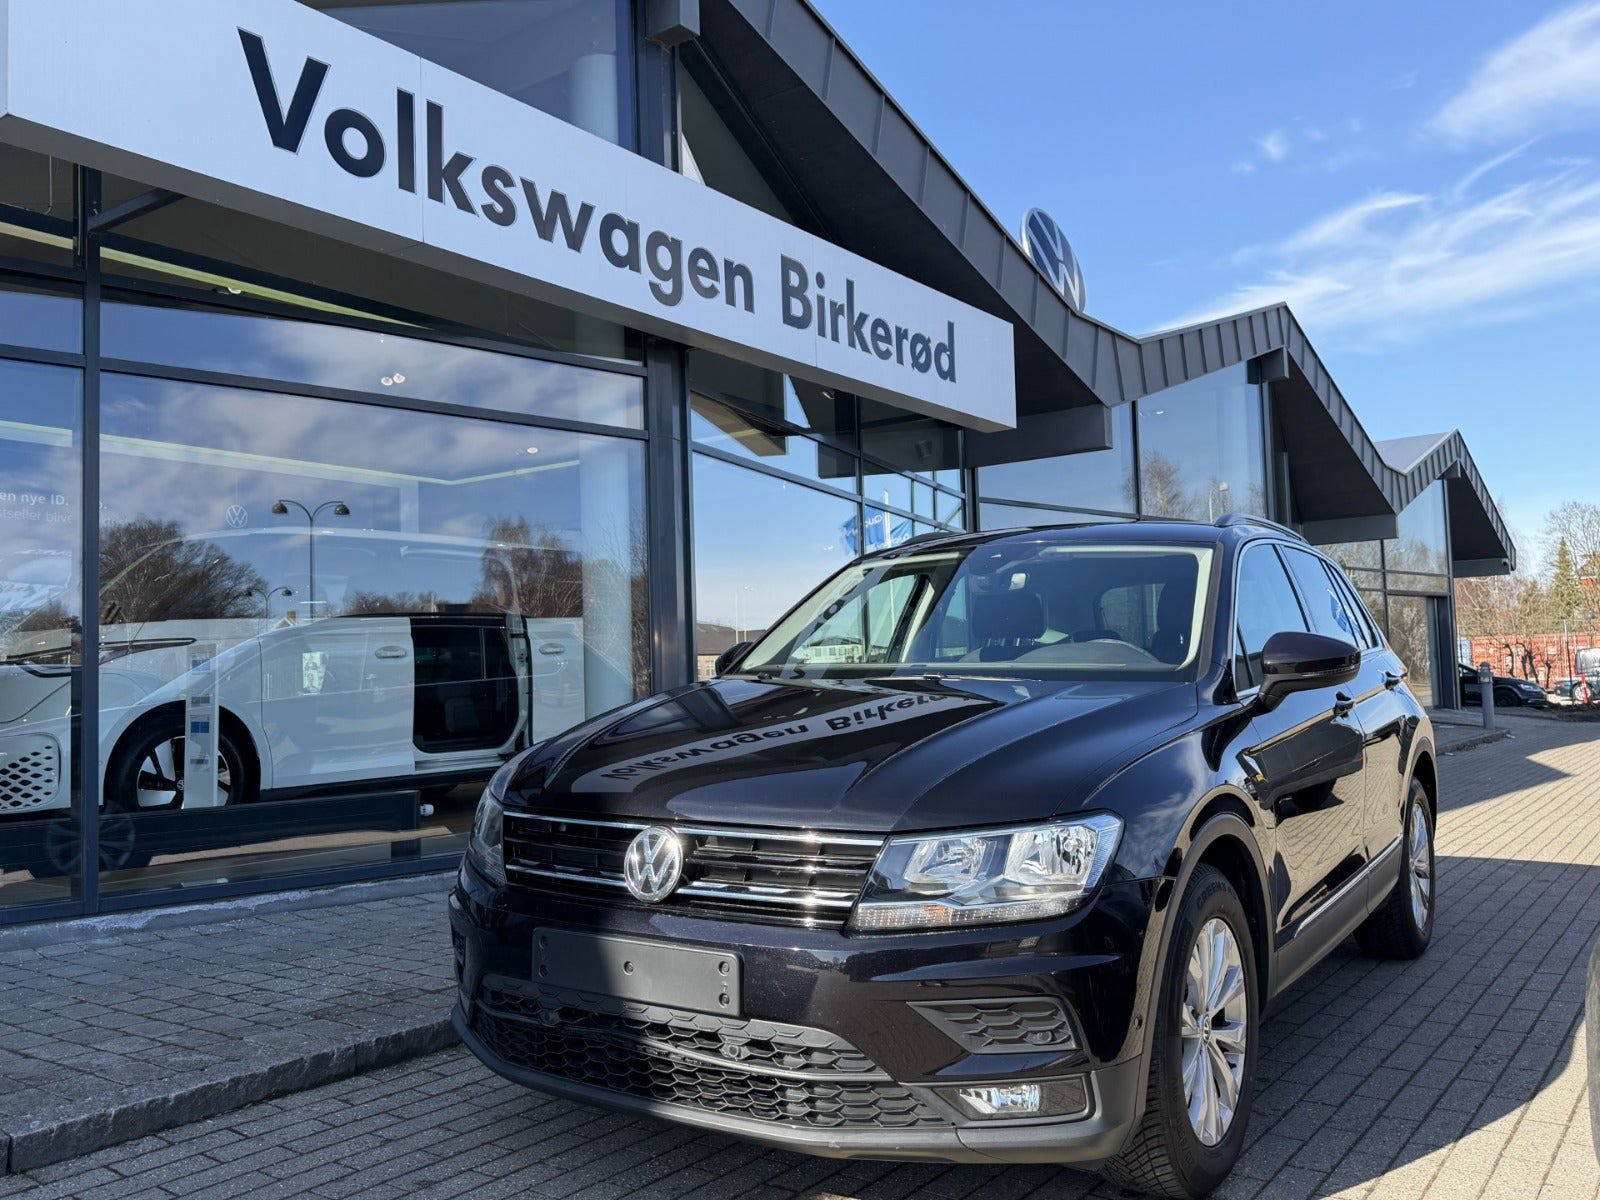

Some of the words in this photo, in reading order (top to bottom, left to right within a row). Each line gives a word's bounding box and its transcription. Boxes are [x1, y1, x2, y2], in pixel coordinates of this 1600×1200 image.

[236, 25, 755, 314] Volkswagen
[780, 253, 957, 384] Birkerød
[21, 494, 46, 506] nye
